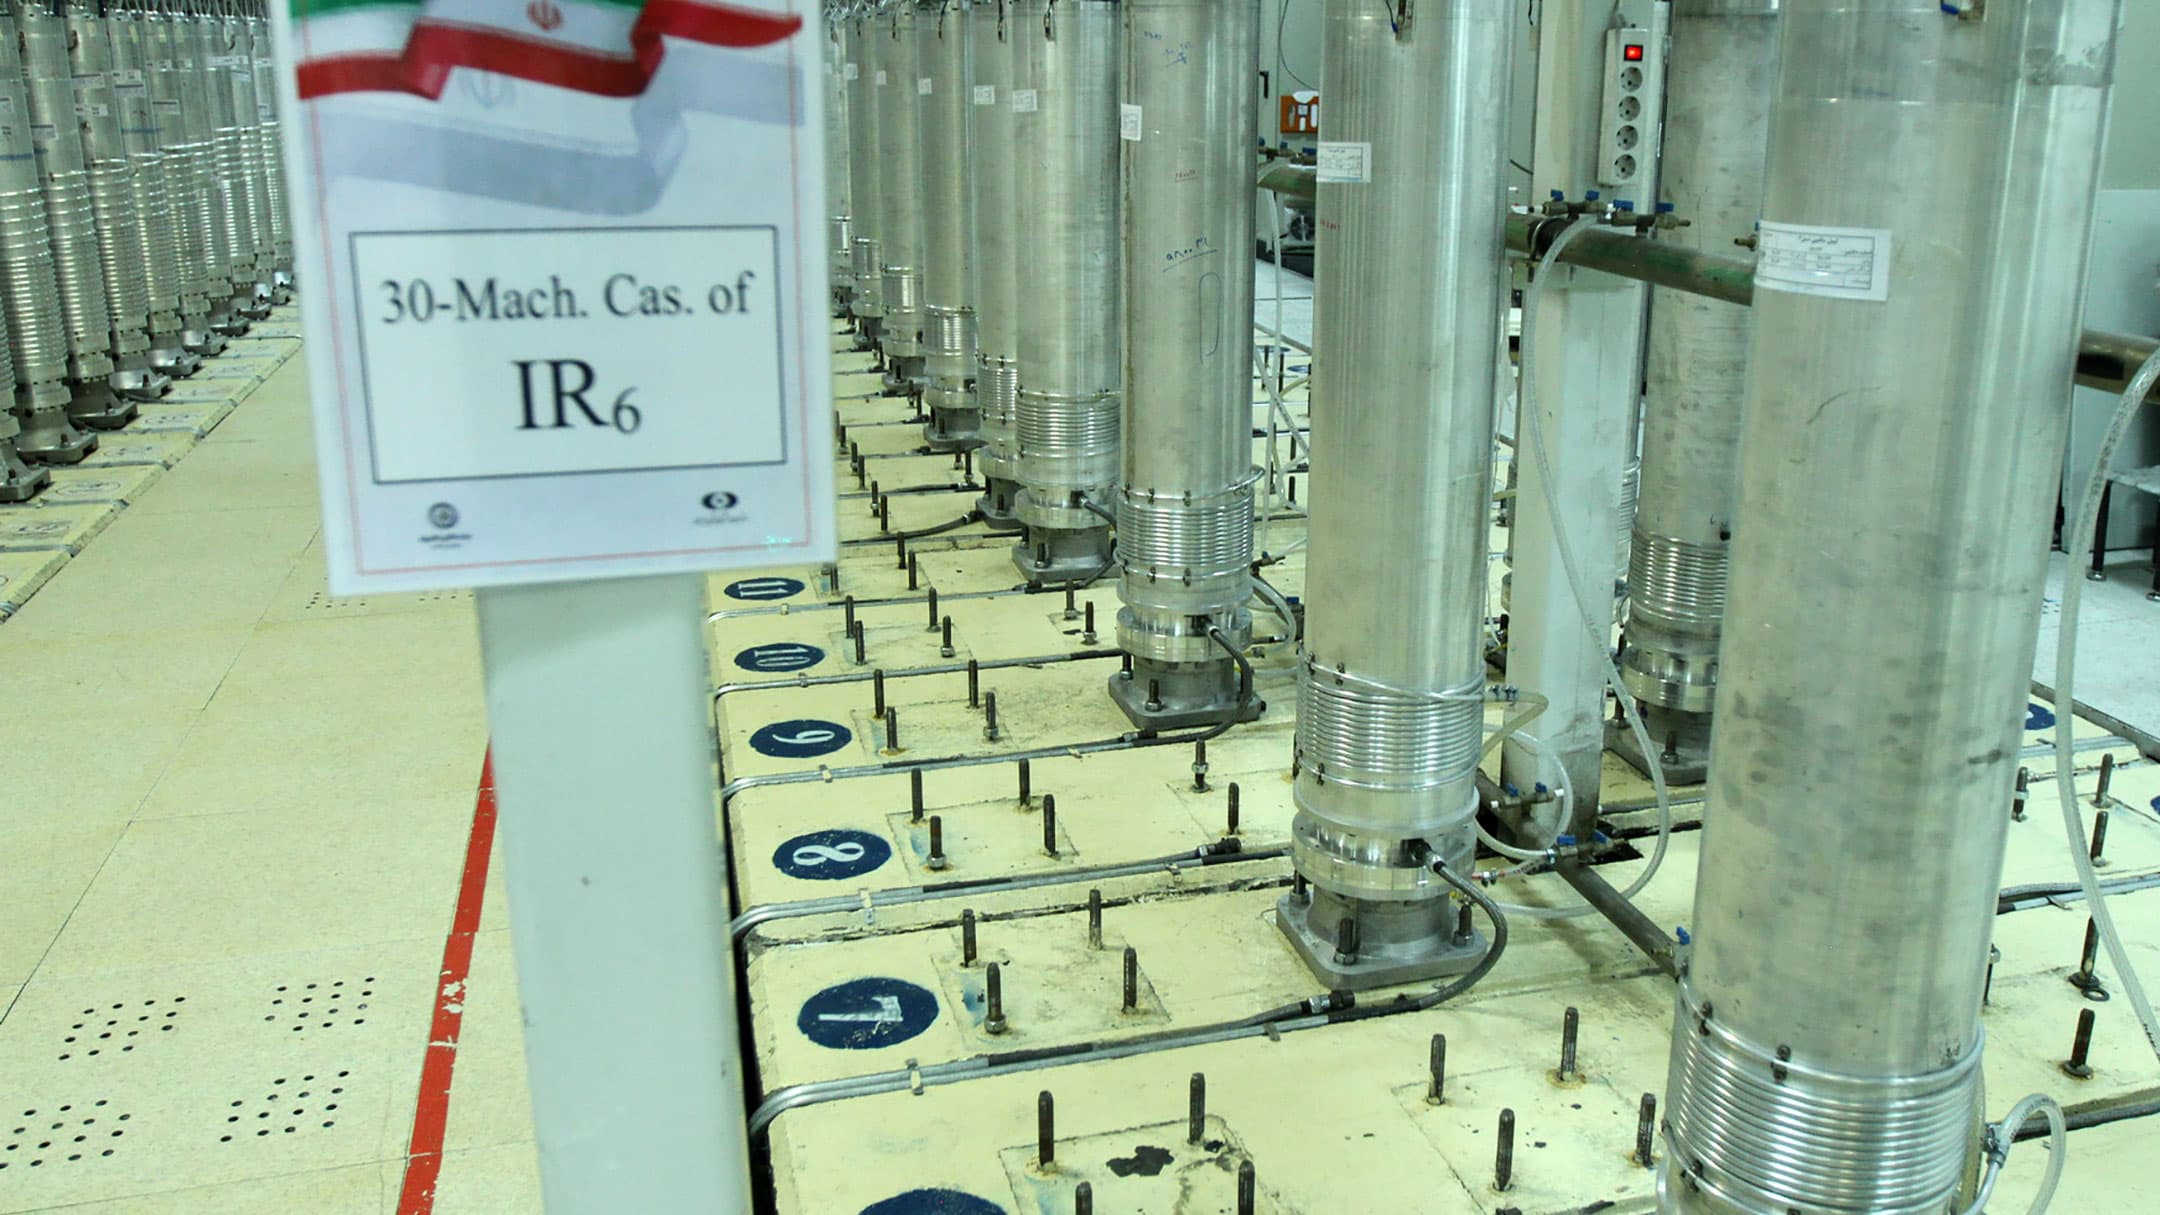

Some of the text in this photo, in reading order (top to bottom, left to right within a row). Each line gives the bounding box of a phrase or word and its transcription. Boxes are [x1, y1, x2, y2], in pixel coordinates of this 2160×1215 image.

[381, 269, 756, 324] 30-Mach. Cas. of
[736, 580, 787, 598] 11
[754, 646, 811, 667] 10
[771, 729, 836, 745] 9
[792, 841, 865, 866] 8
[817, 995, 904, 1022] 7
